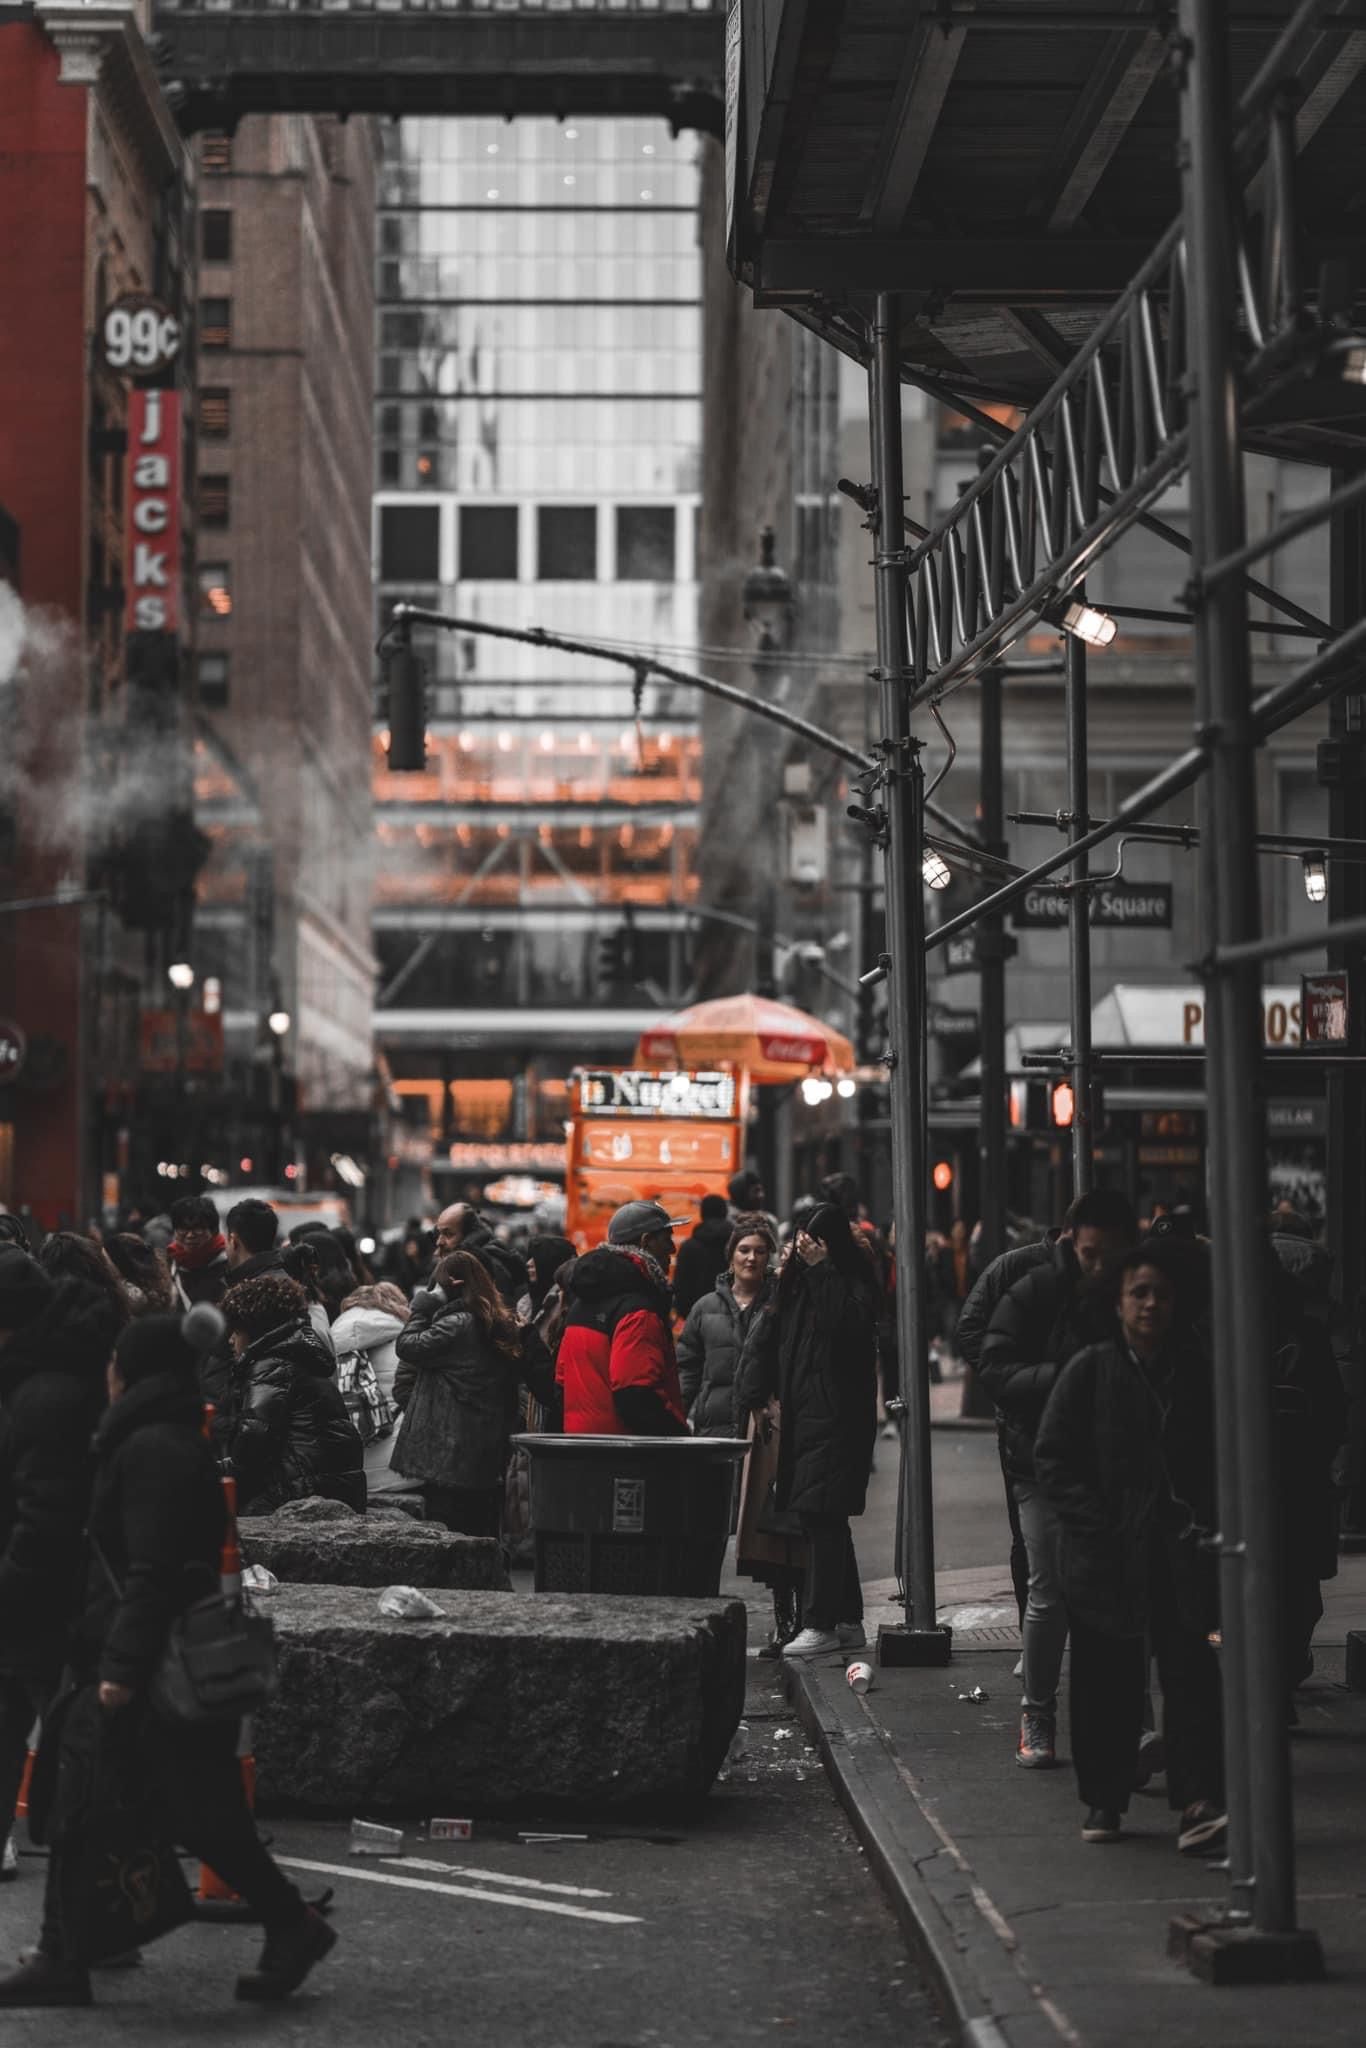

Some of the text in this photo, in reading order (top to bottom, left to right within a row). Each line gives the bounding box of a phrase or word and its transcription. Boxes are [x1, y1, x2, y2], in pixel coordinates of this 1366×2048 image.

[104, 308, 179, 367] 99¢
[133, 389, 169, 631] jacks
[1024, 889, 1166, 921] Greey Square
